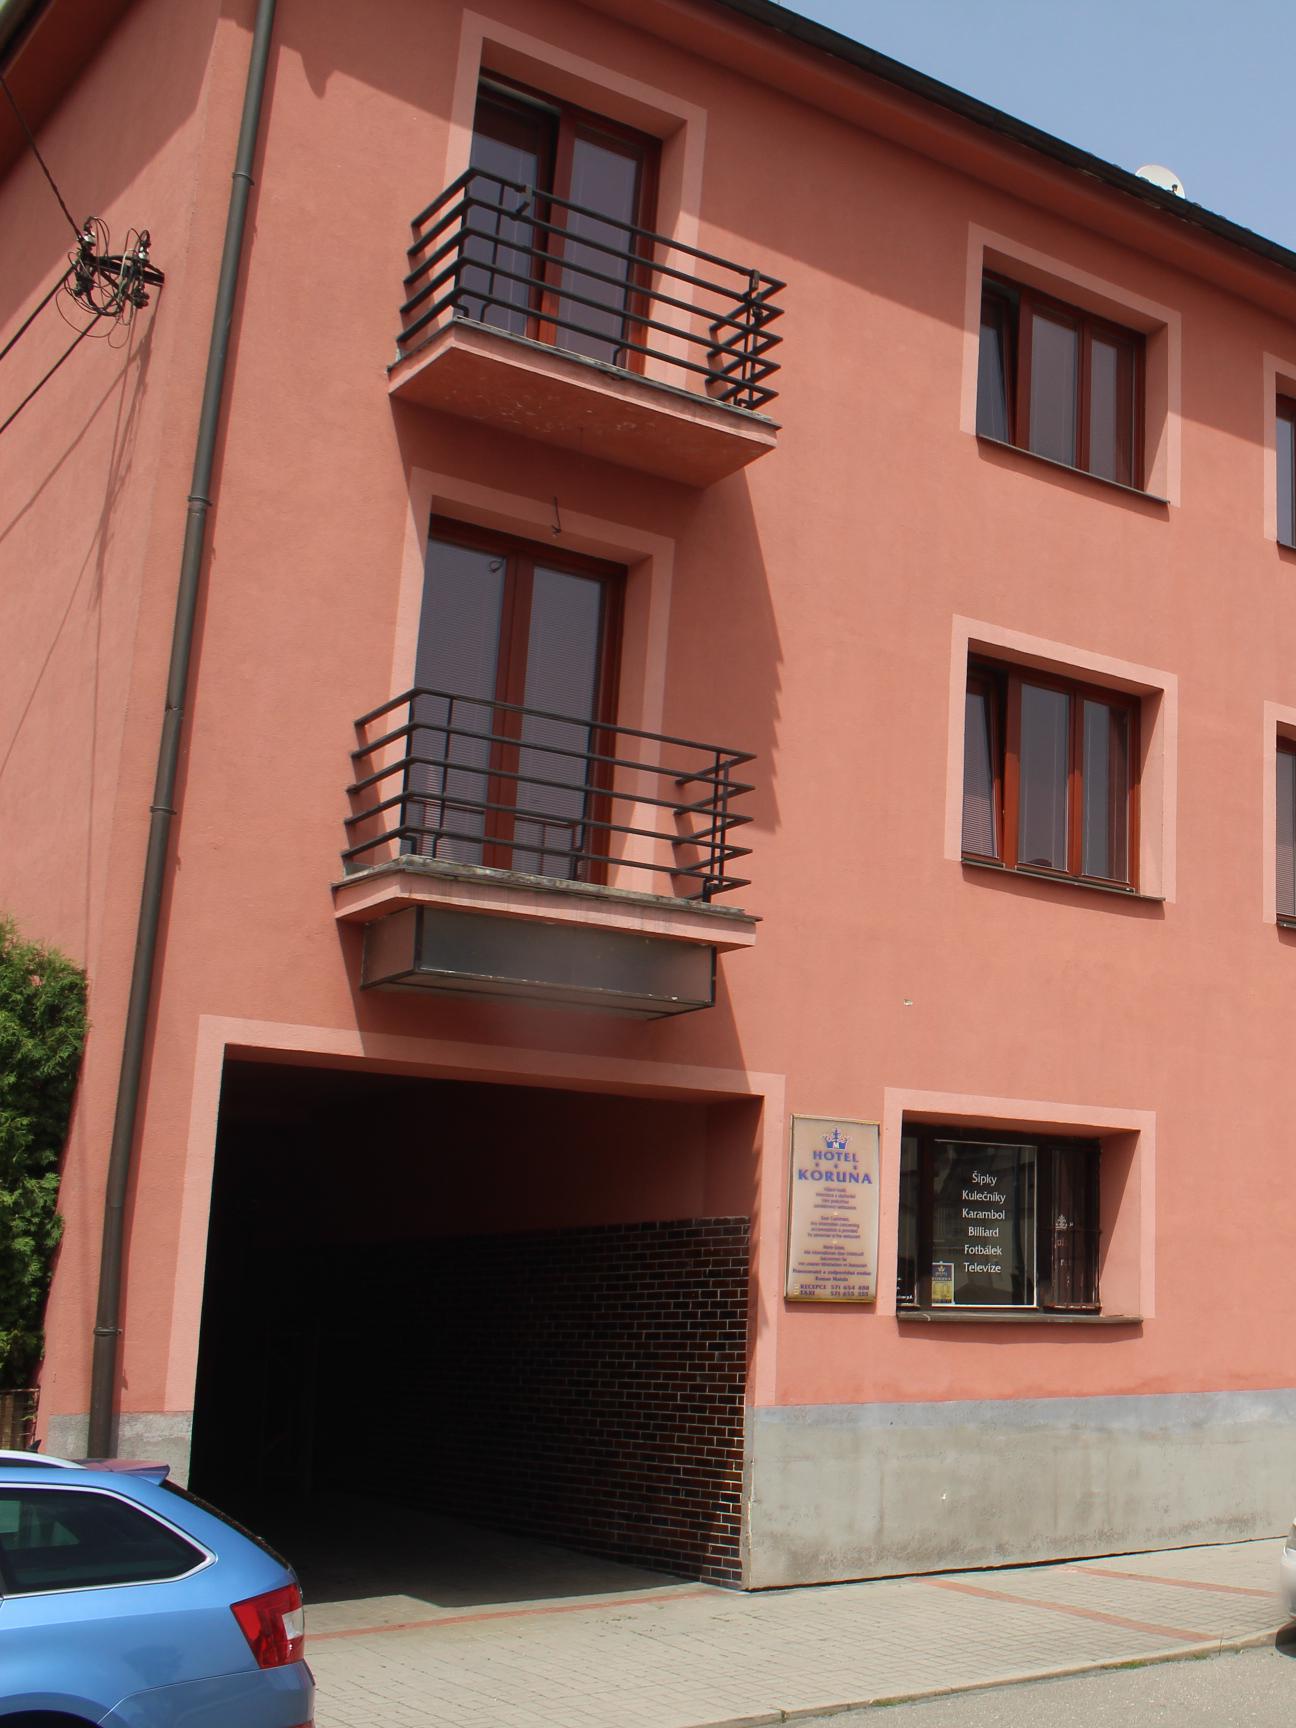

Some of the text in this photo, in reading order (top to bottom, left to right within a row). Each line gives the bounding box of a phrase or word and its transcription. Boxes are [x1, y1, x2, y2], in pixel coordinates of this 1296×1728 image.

[813, 1151, 859, 1162] HOTEL
[798, 1169, 872, 1184] KORUNA
[972, 1171, 997, 1186] Šipky
[962, 1190, 1006, 1204] Kulečníky
[962, 1208, 1005, 1220] Karambol
[968, 1226, 999, 1237] Billiard
[964, 1244, 1002, 1255] Fotbálek
[963, 1262, 1001, 1273] Televize
